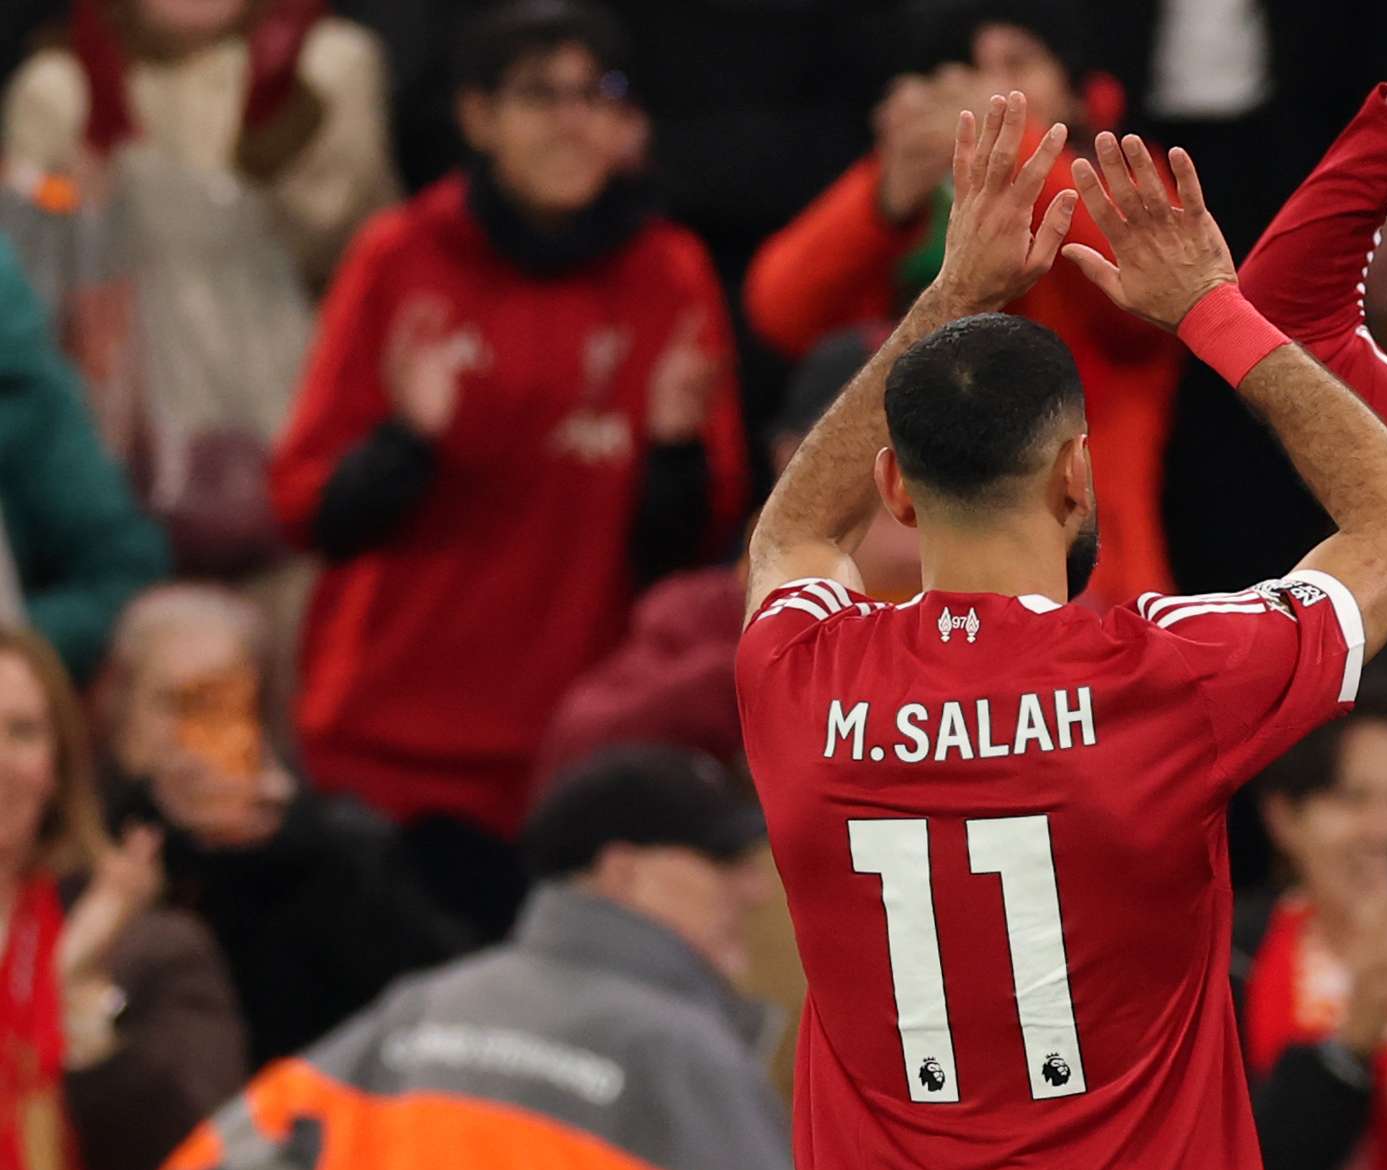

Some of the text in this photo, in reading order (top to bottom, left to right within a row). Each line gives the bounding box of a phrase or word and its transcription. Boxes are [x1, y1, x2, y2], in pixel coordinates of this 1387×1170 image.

[951, 616, 968, 629] 97
[823, 685, 1098, 763] M.SALAH
[846, 813, 1088, 1103] 11
